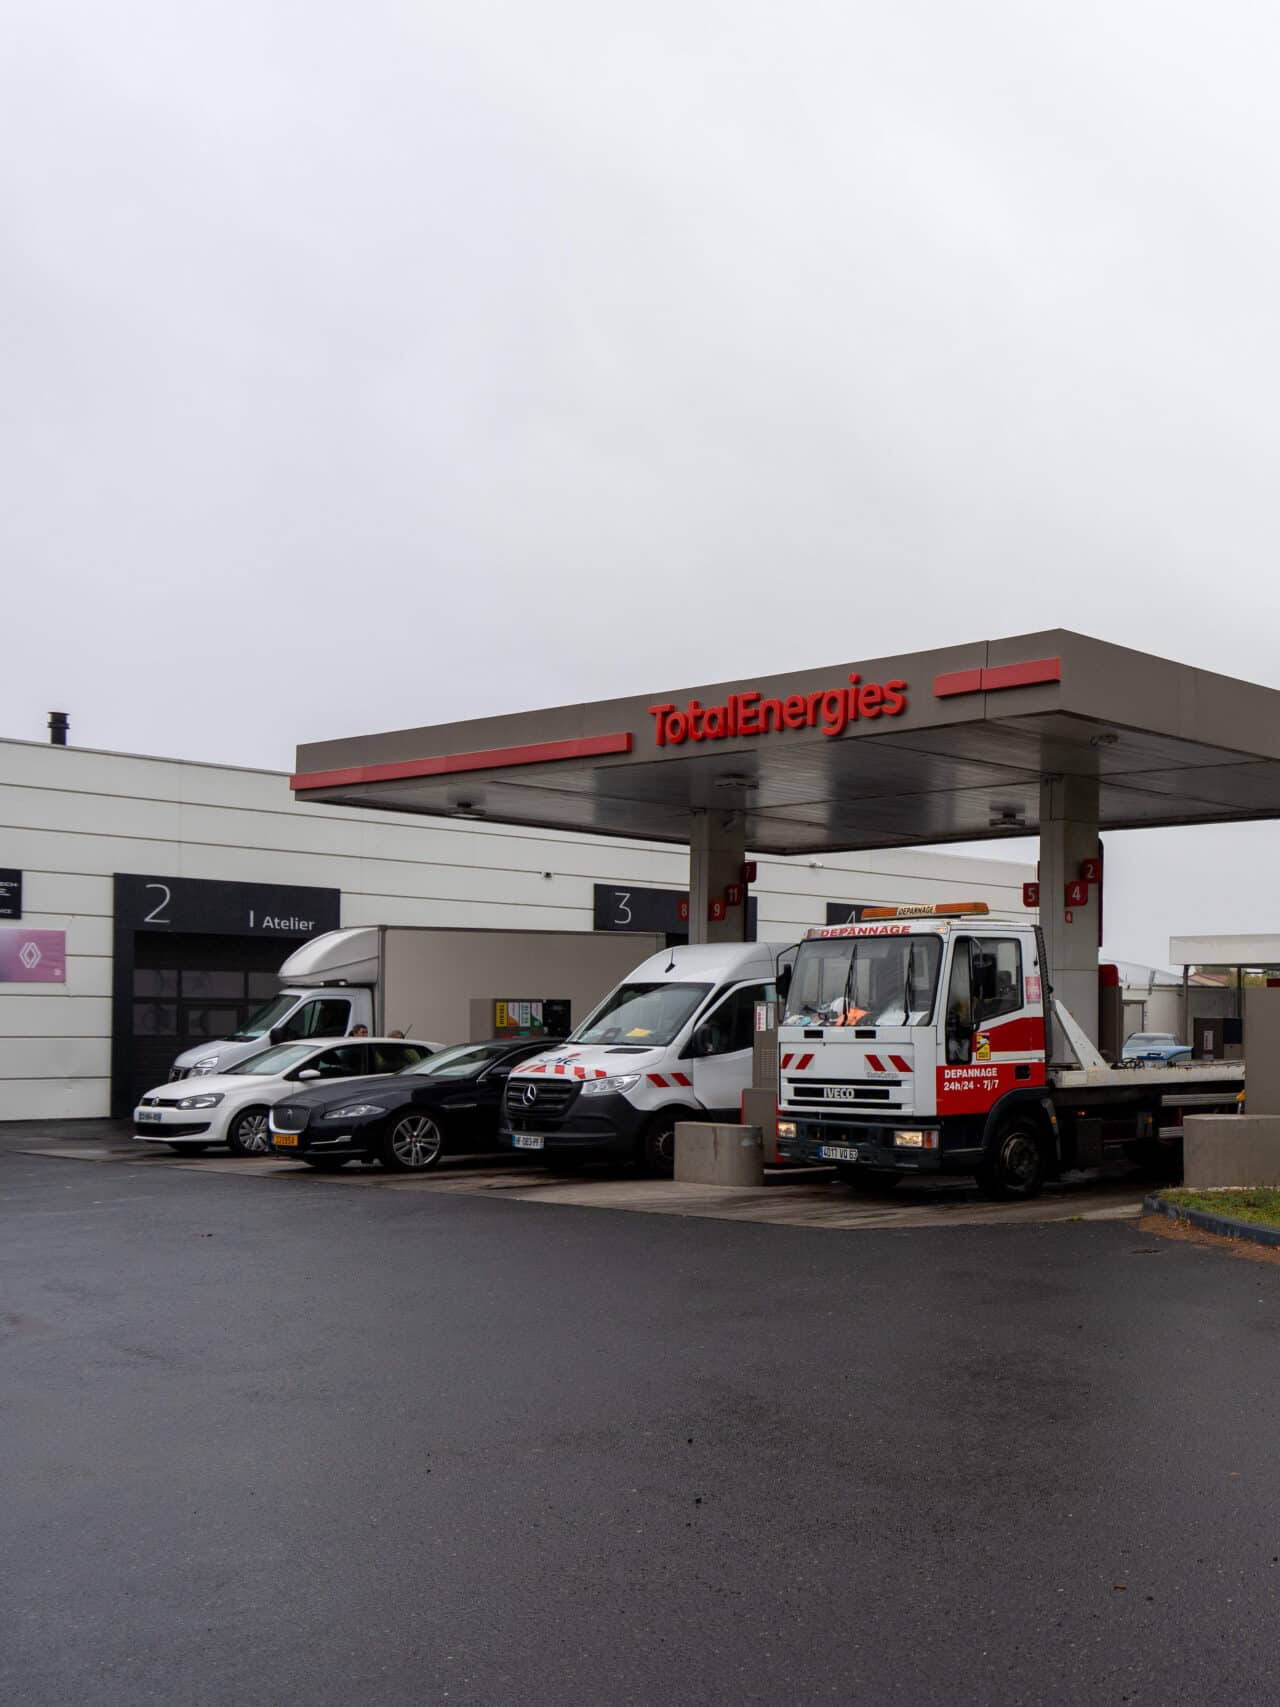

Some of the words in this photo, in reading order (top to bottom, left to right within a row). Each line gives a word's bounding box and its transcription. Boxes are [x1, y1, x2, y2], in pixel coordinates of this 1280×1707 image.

[648, 672, 908, 746] TotalEnergies
[1086, 863, 1096, 879] 2
[1027, 886, 1036, 903] 5
[1072, 884, 1081, 902] 4
[143, 883, 171, 924] 2
[613, 891, 633, 925] 3
[680, 902, 688, 917] 8
[713, 902, 721, 917] 9
[262, 915, 316, 931] Atelier
[820, 924, 913, 938] DEPANNAGE
[944, 1067, 998, 1078] DEPANNAGE
[823, 1087, 855, 1099] IVECO
